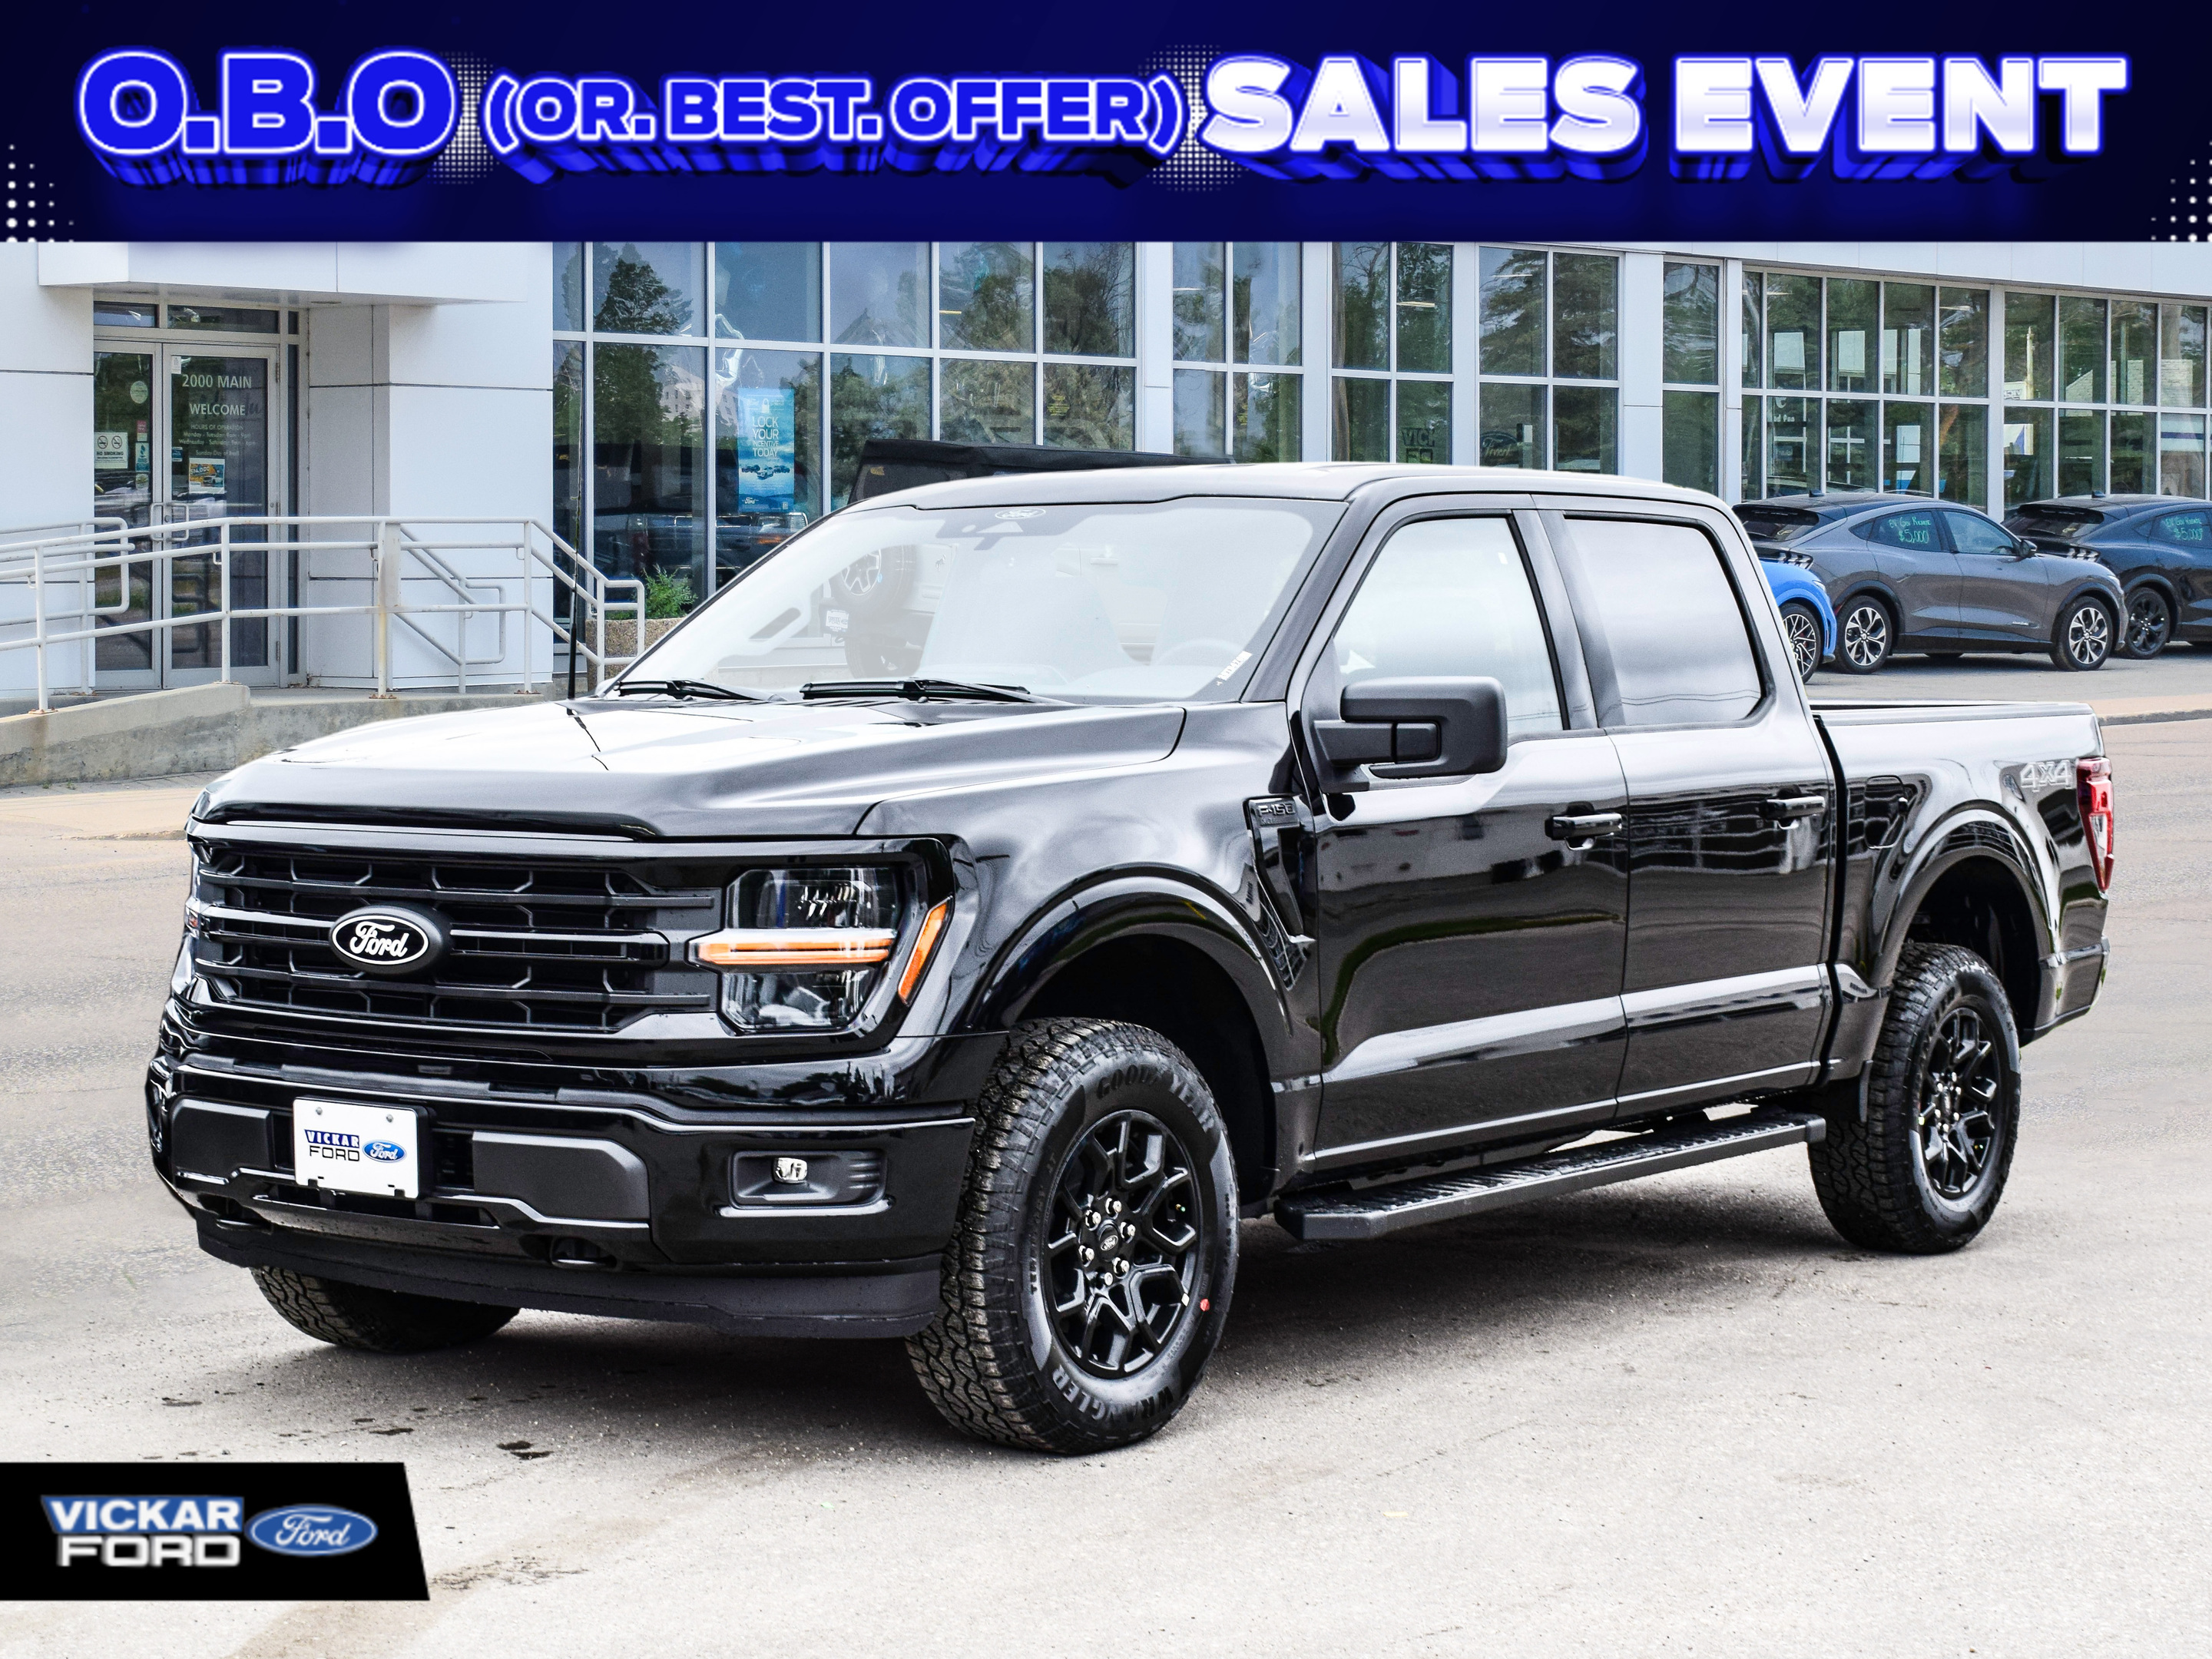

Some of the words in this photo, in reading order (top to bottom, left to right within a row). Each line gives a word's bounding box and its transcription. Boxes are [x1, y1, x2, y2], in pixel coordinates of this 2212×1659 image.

[182, 374, 214, 388] 2000
[217, 375, 252, 389] MAIN
[189, 403, 246, 416] WELCOME
[752, 416, 779, 428] LOCK
[752, 428, 780, 440] YOUR
[752, 448, 779, 457] TODAY
[1258, 803, 1296, 816] F-150
[349, 921, 409, 958] Ford
[307, 1131, 359, 1147] VICKAR
[310, 1145, 360, 1162] FORD
[369, 1141, 398, 1161] Ford
